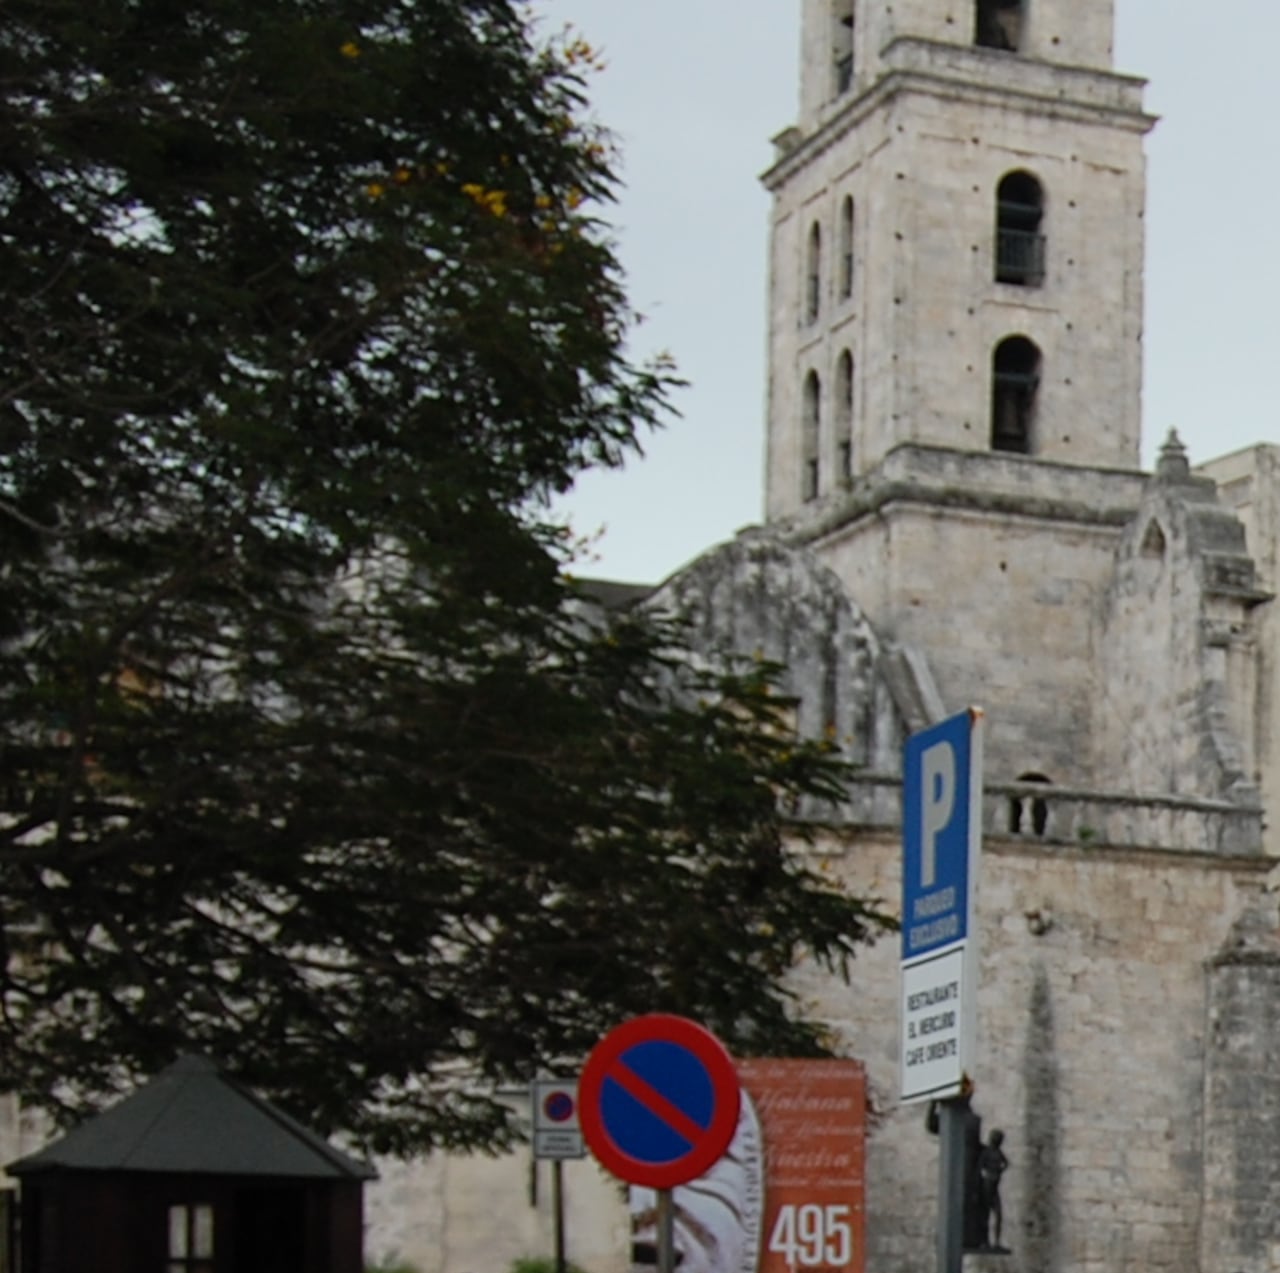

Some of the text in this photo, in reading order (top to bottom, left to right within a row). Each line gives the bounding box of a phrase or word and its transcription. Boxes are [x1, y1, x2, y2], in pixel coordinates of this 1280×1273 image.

[919, 738, 956, 888] P
[907, 980, 959, 1013] RESTAURANTE
[908, 1021, 918, 1040] EL
[768, 1203, 852, 1267] 495
